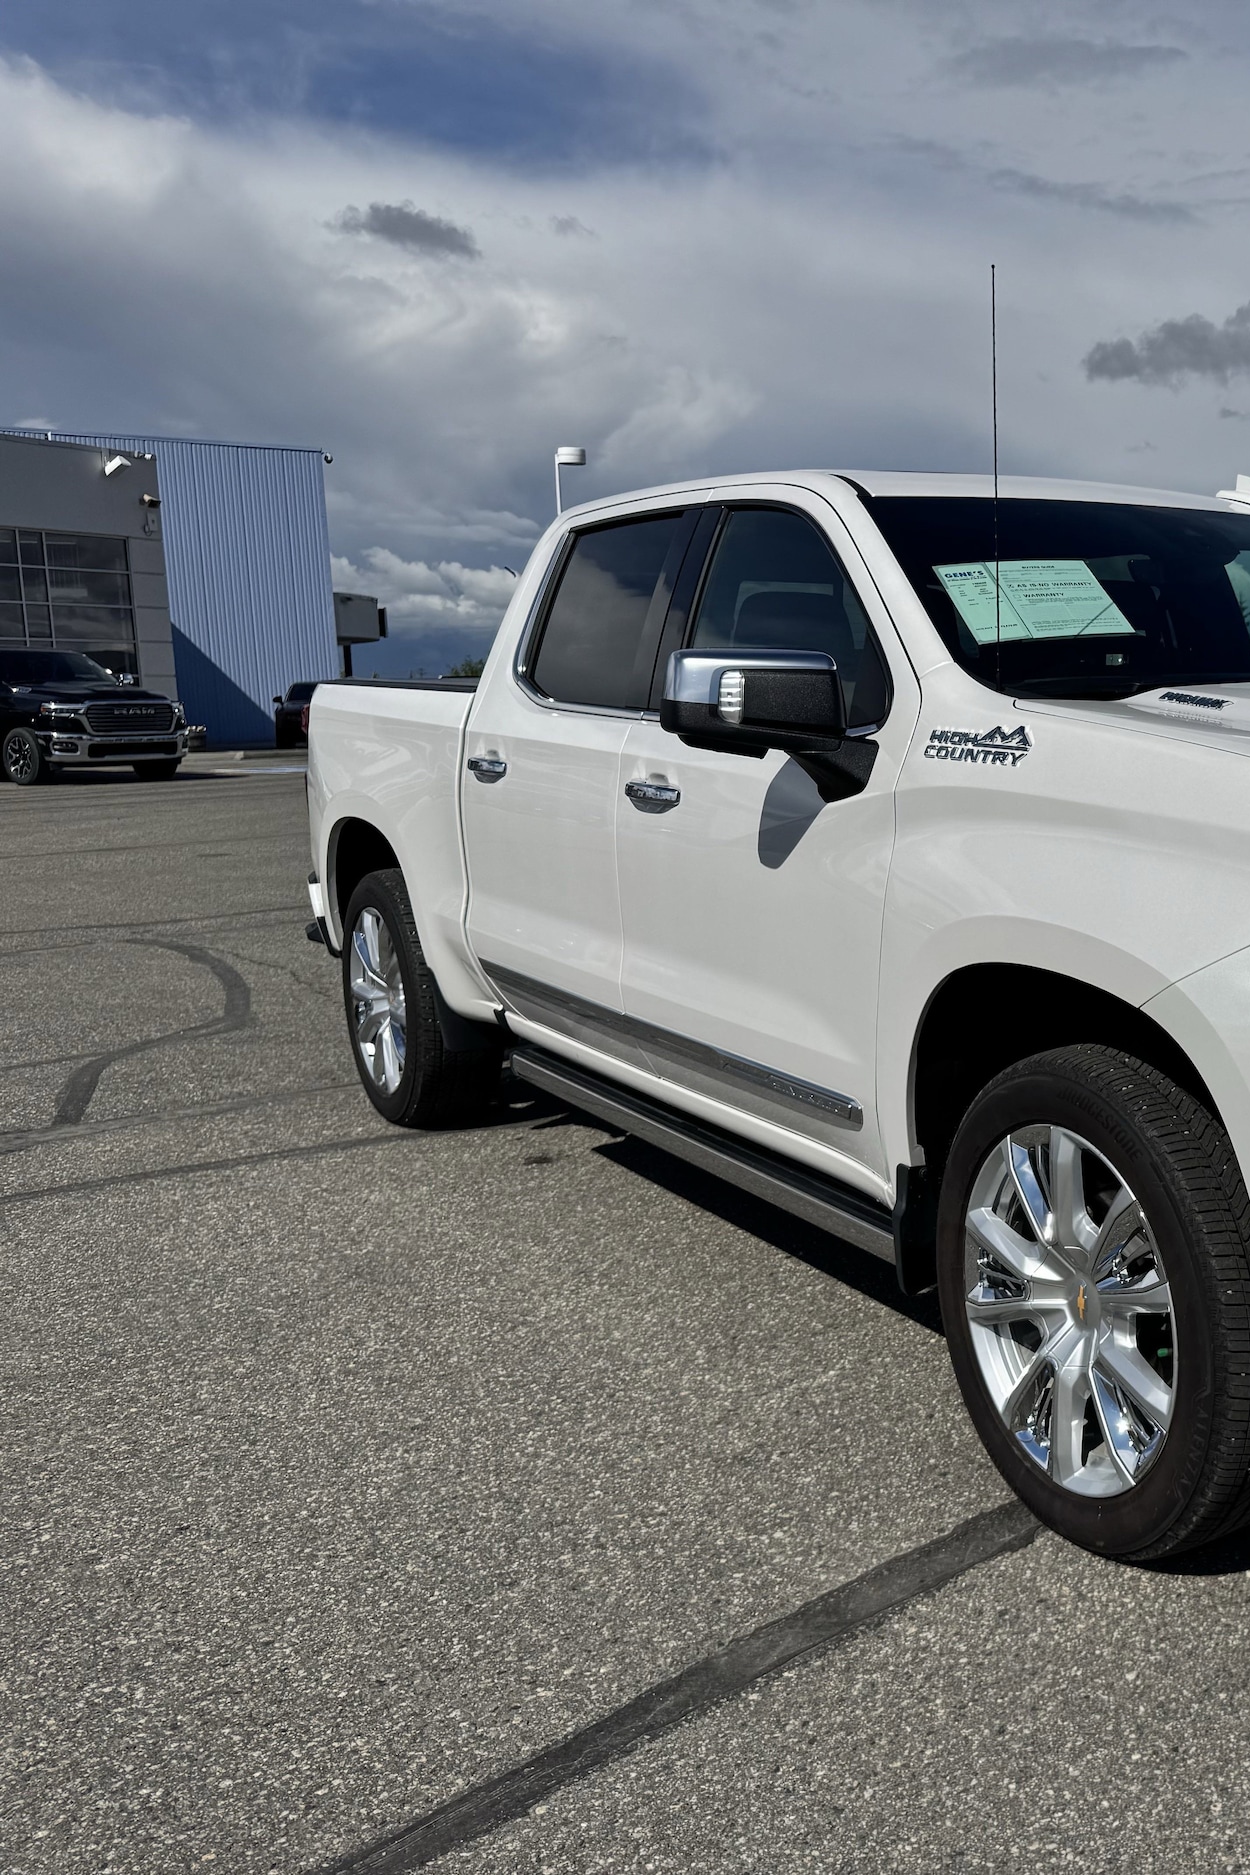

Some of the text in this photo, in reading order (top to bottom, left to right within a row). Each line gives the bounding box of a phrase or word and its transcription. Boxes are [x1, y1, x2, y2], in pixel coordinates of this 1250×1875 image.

[944, 570, 984, 578] GENE'S
[929, 729, 980, 746] HIGH
[924, 745, 1028, 766] COUNTRY
